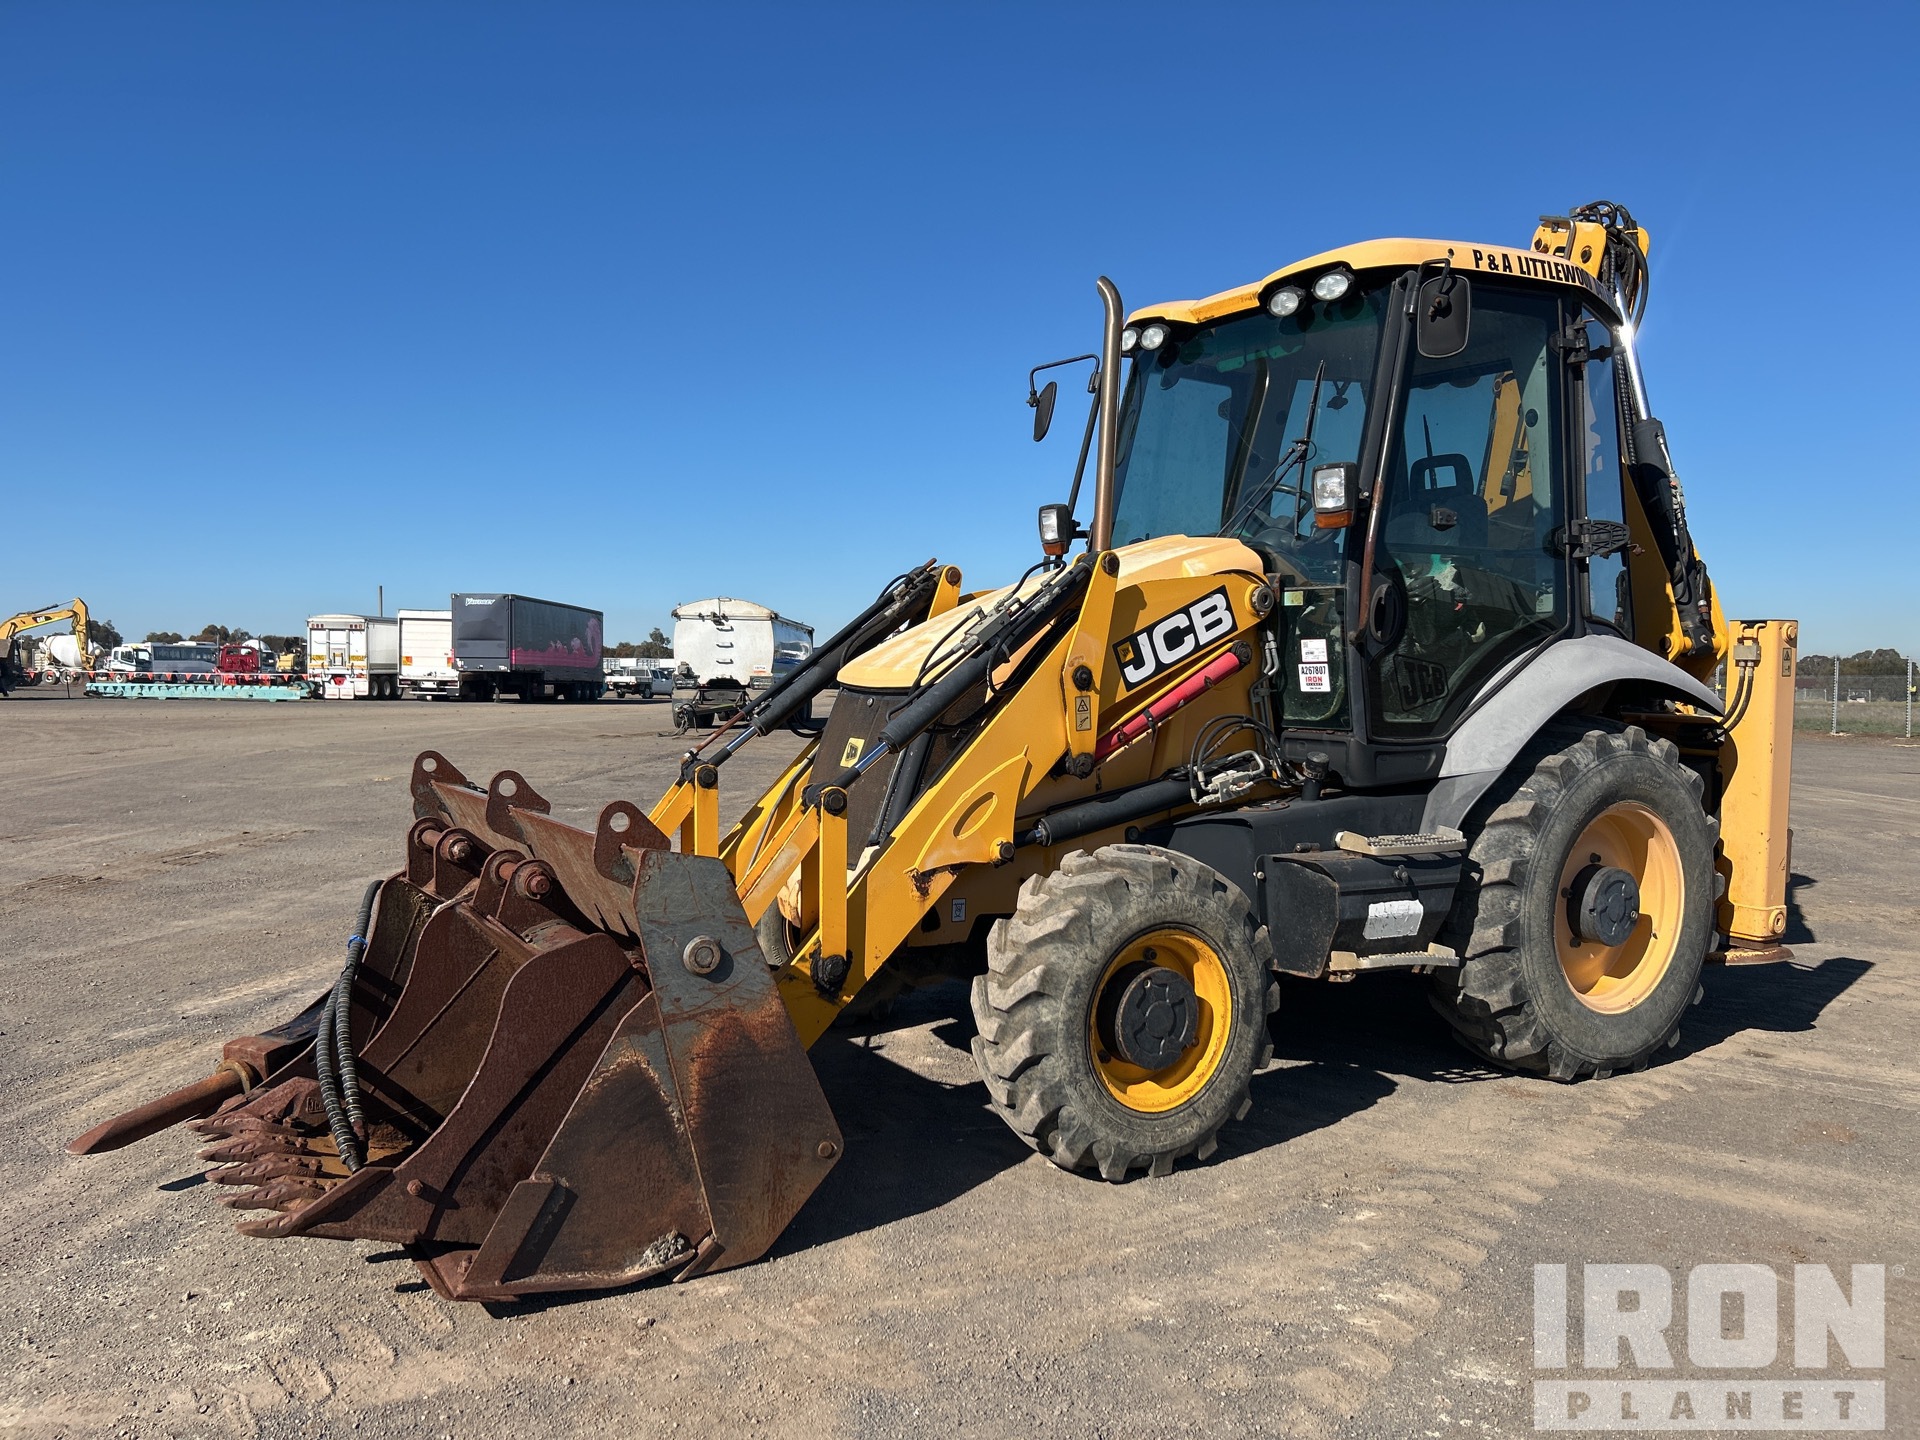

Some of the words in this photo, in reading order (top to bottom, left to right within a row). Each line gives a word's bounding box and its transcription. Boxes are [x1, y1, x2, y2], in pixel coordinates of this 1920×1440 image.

[1123, 593, 1233, 683] JCB
[1301, 665, 1326, 675] A267807
[1402, 661, 1445, 705] JCB
